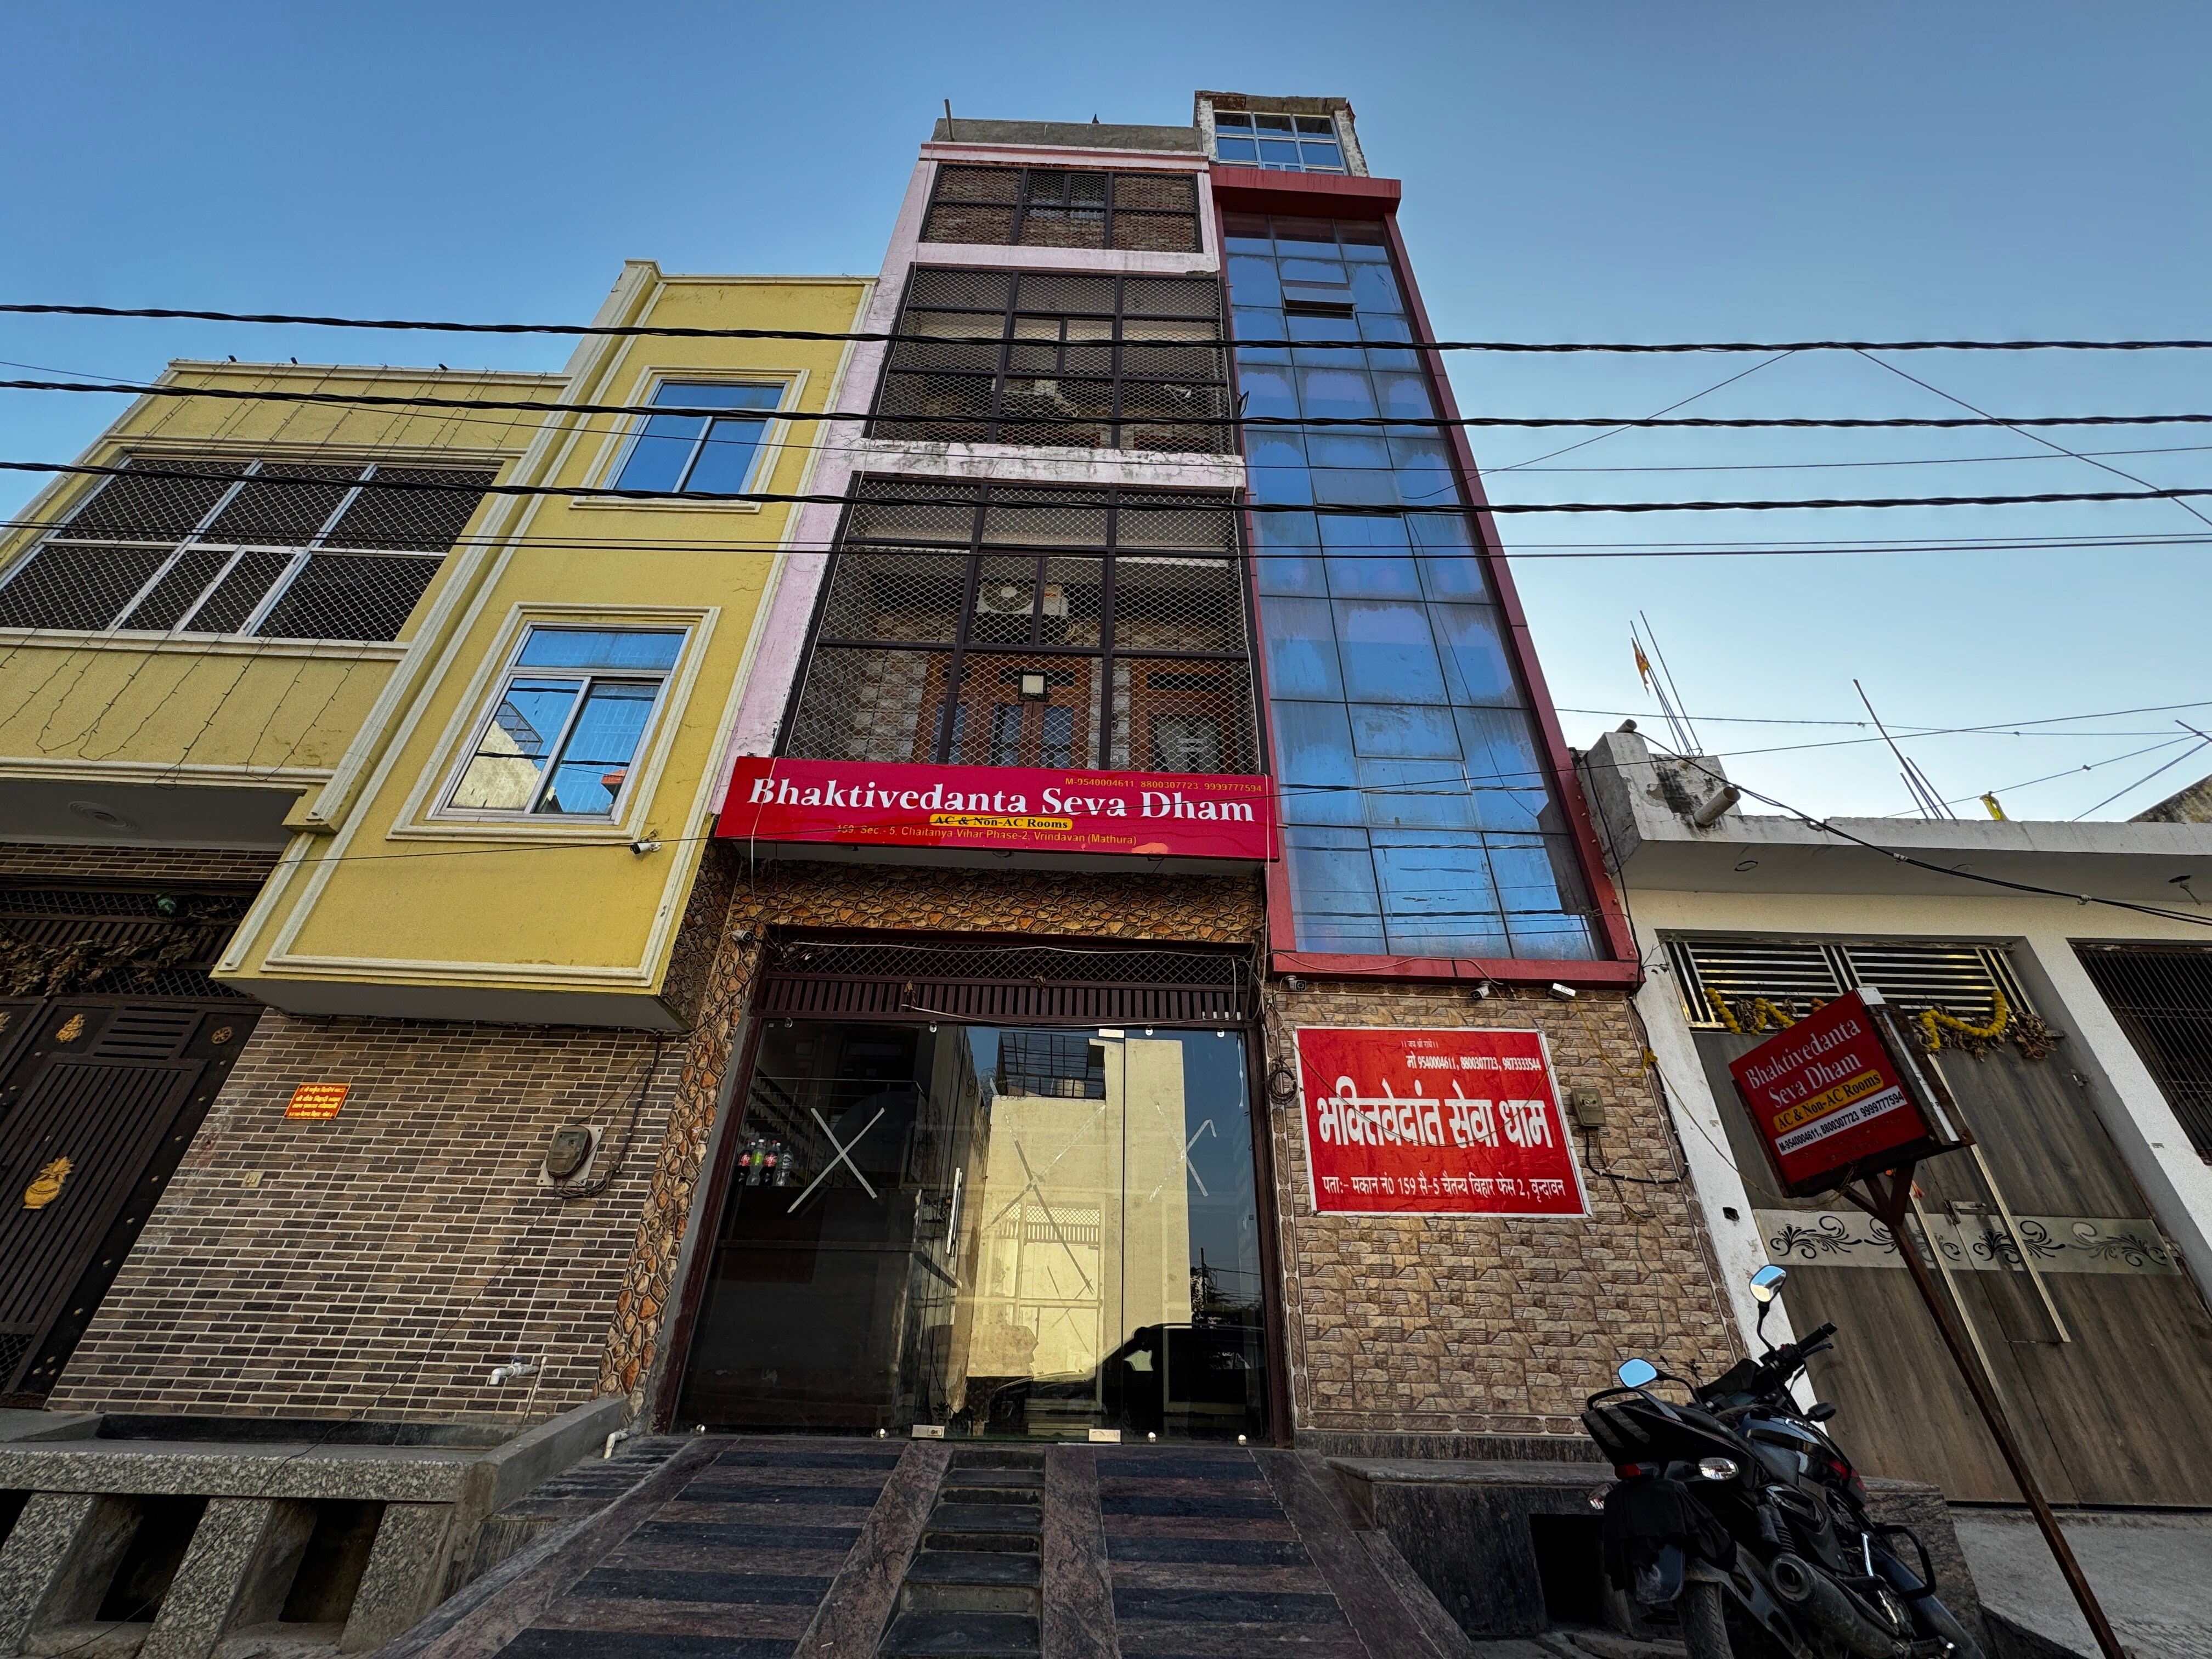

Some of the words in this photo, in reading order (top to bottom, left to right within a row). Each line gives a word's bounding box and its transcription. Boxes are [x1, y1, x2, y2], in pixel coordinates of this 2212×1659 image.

[747, 777, 1028, 814] Bhaktivedanta
[1042, 787, 1127, 816] Seva
[1139, 791, 1255, 822] Dham
[1204, 782, 1262, 792] 9999777594
[901, 826, 953, 839] Chaitanya
[957, 828, 983, 838] Vihar
[1034, 831, 1085, 842] Vrindavan
[1088, 833, 1137, 846] (Mathura)
[935, 816, 958, 825] AC
[958, 816, 969, 825] &
[974, 816, 1023, 827] Non-AC
[1026, 819, 1068, 828] Rooms
[1745, 1019, 1861, 1090] Bhaktivedanta
[1768, 1080, 1808, 1108] Seva
[1804, 1053, 1864, 1090] Dham
[1317, 1075, 1445, 1147] भक्तिवेदांत
[1444, 1078, 1499, 1149] सेवा
[1499, 1099, 1553, 1148] धाम
[1778, 1112, 1793, 1130] AC
[1794, 1108, 1804, 1121] &
[1802, 1089, 1843, 1116] Non-AC
[1842, 1073, 1881, 1098] Rooms
[1860, 1091, 1904, 1118] 9999777594
[1350, 1176, 1380, 1195] मकान
[1397, 1177, 1416, 1195] 159
[1440, 1170, 1469, 1195] चैतन्य
[1468, 1171, 1496, 1198] विहार
[1495, 1171, 1516, 1197] फेस
[1517, 1178, 1530, 1200] 2,
[1528, 1178, 1566, 1203] वृन्दावन
